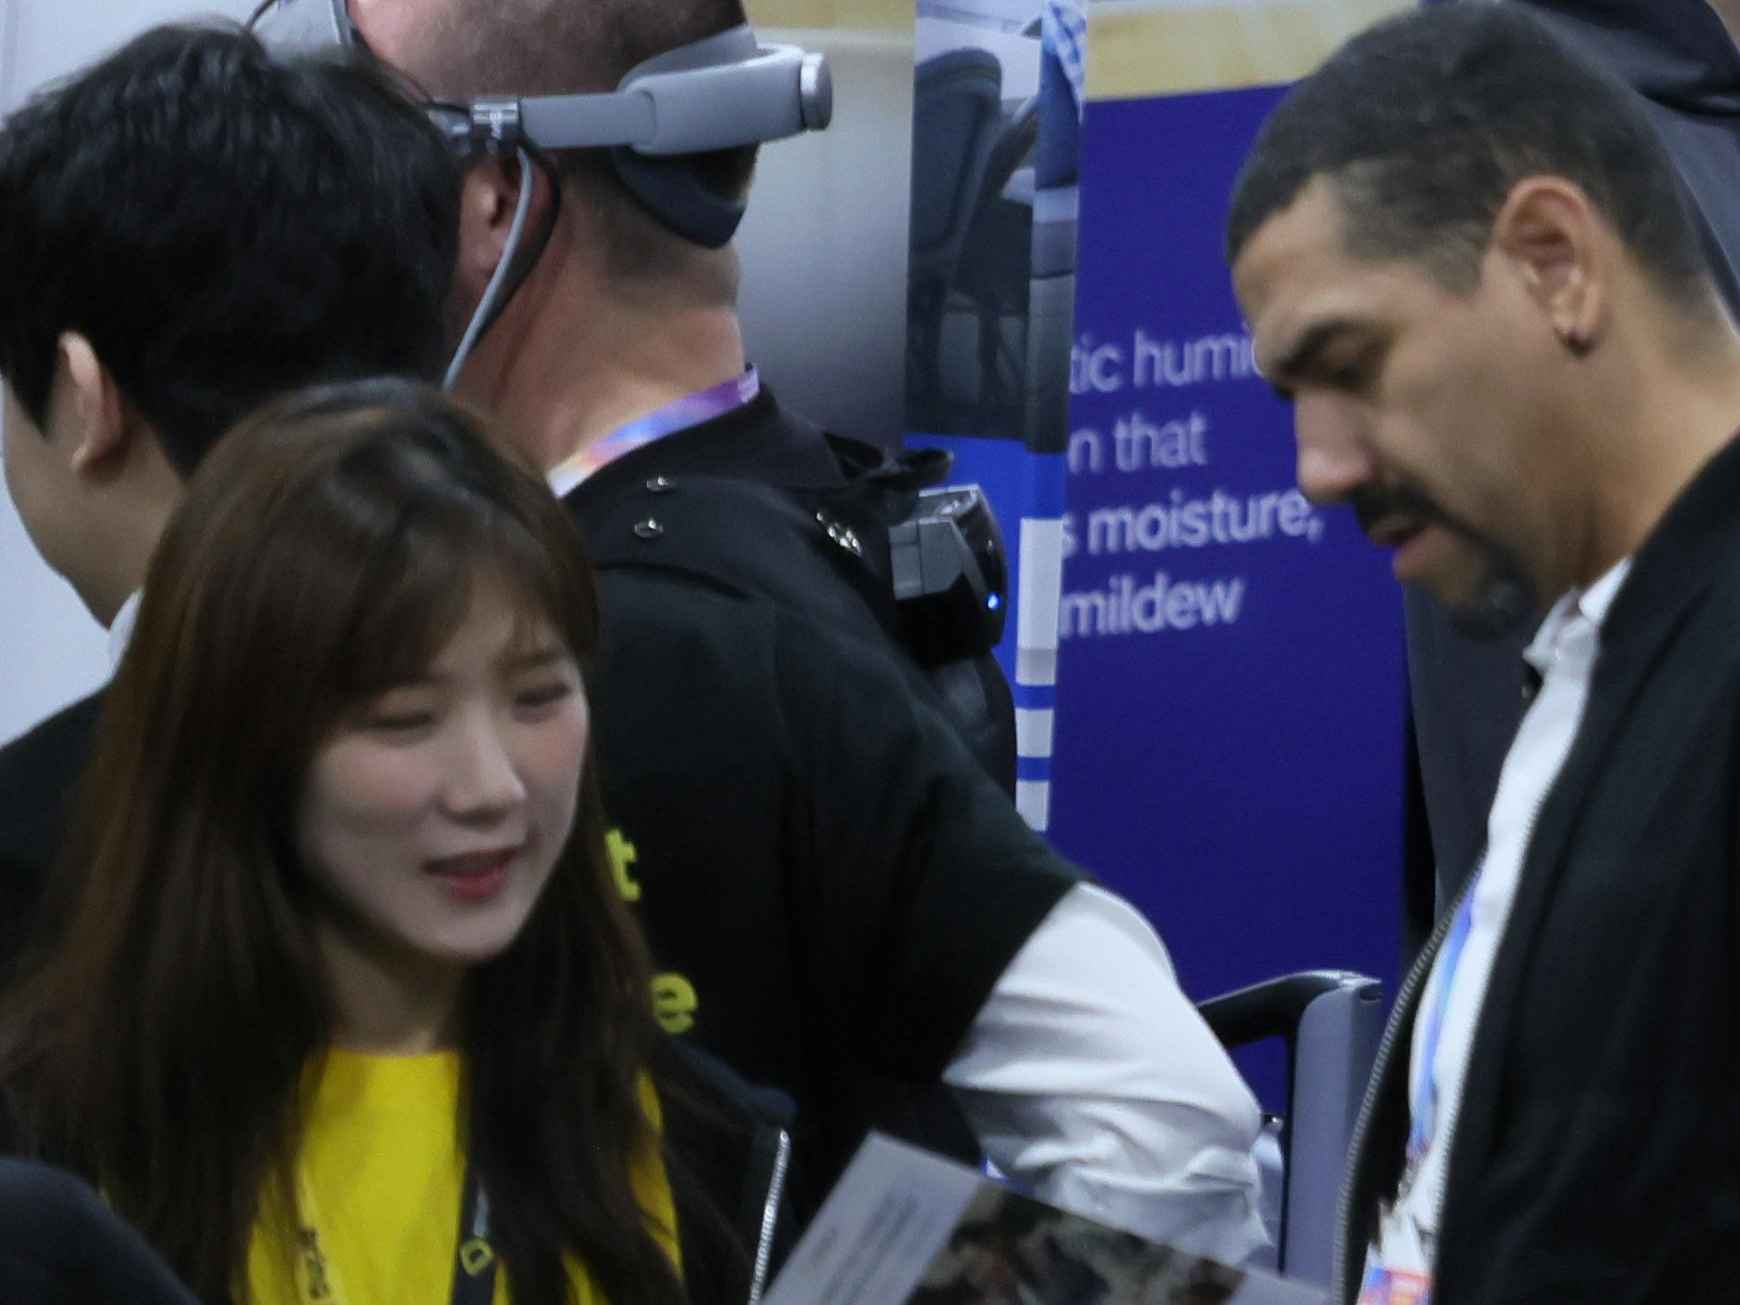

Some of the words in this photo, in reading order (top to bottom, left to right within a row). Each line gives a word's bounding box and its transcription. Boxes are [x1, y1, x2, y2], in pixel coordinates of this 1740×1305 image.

[1133, 328, 1264, 388] humi
[1114, 410, 1208, 473] that
[1088, 487, 1327, 556] moisture,
[1058, 571, 1245, 638] mildew
